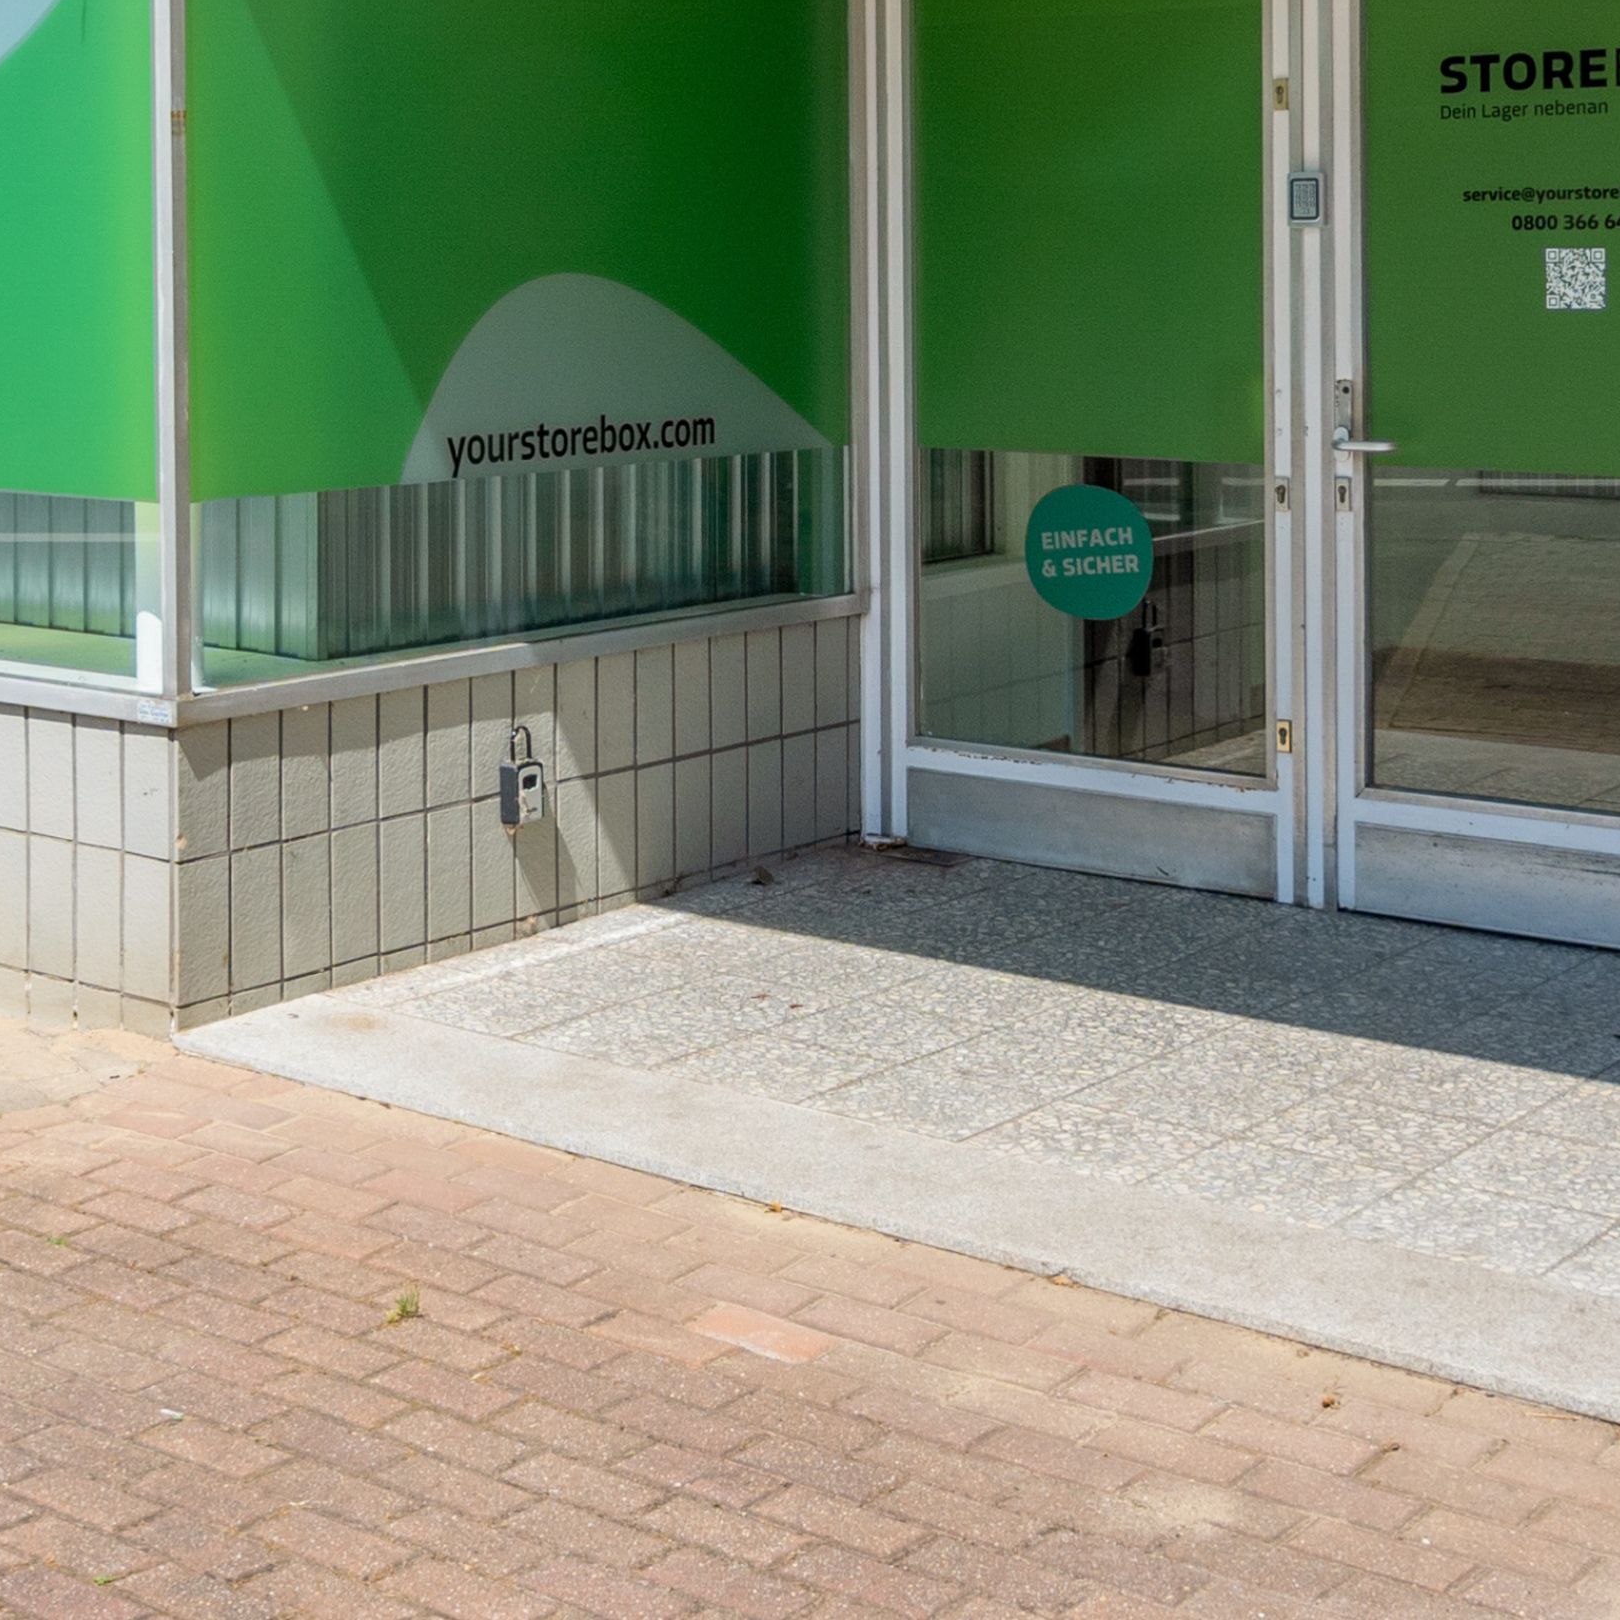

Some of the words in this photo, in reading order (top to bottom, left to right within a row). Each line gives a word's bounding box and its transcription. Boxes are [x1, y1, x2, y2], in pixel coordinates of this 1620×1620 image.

[1440, 103, 1476, 120] Dein
[1481, 103, 1528, 122] Lager
[1533, 100, 1609, 116] nebenan
[1511, 215, 1558, 230] 0800
[1564, 214, 1599, 230] 366
[447, 415, 716, 478] yourstorebox.com
[1041, 527, 1133, 550] EINFACH
[1042, 559, 1057, 577] &
[1062, 554, 1140, 576] SICHER
